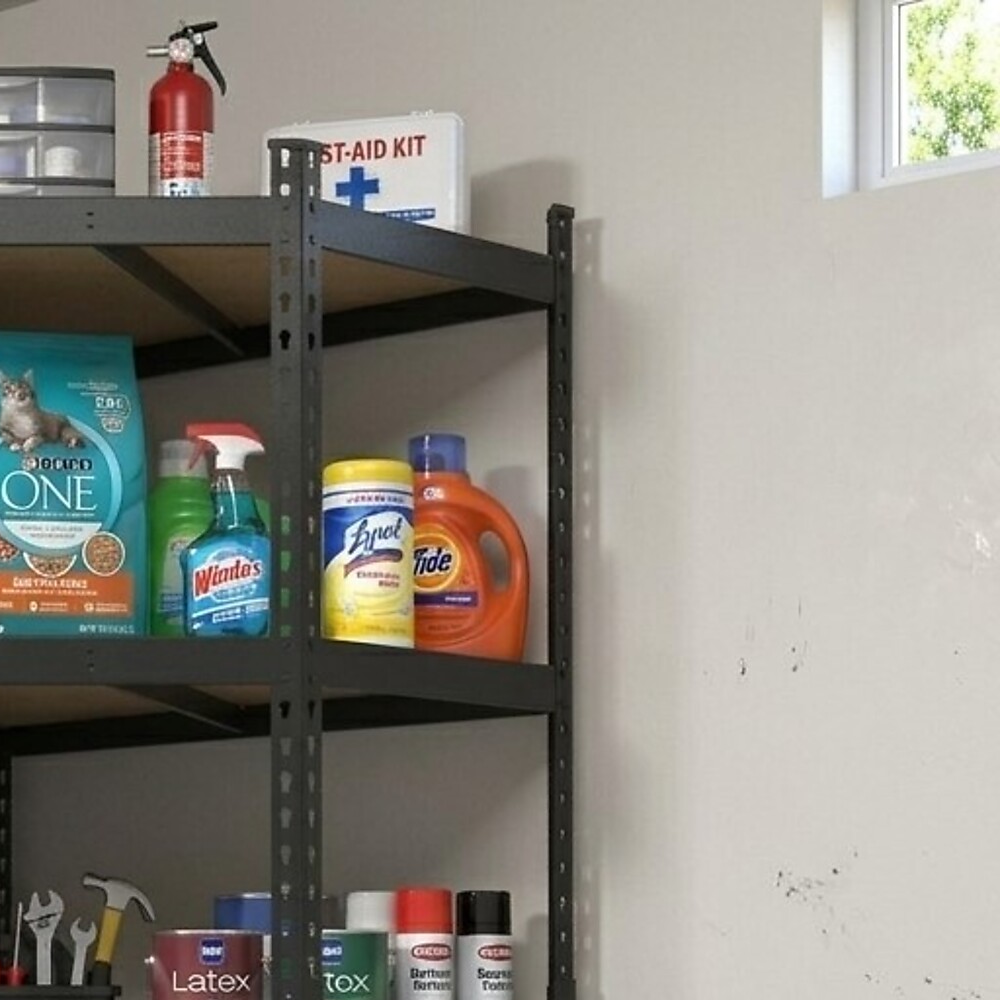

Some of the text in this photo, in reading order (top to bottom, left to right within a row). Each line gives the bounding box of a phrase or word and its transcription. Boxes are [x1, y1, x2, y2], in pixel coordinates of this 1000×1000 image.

[320, 134, 427, 164] ST-AID KIT
[1, 470, 98, 511] ONE
[173, 970, 251, 993] Latex
